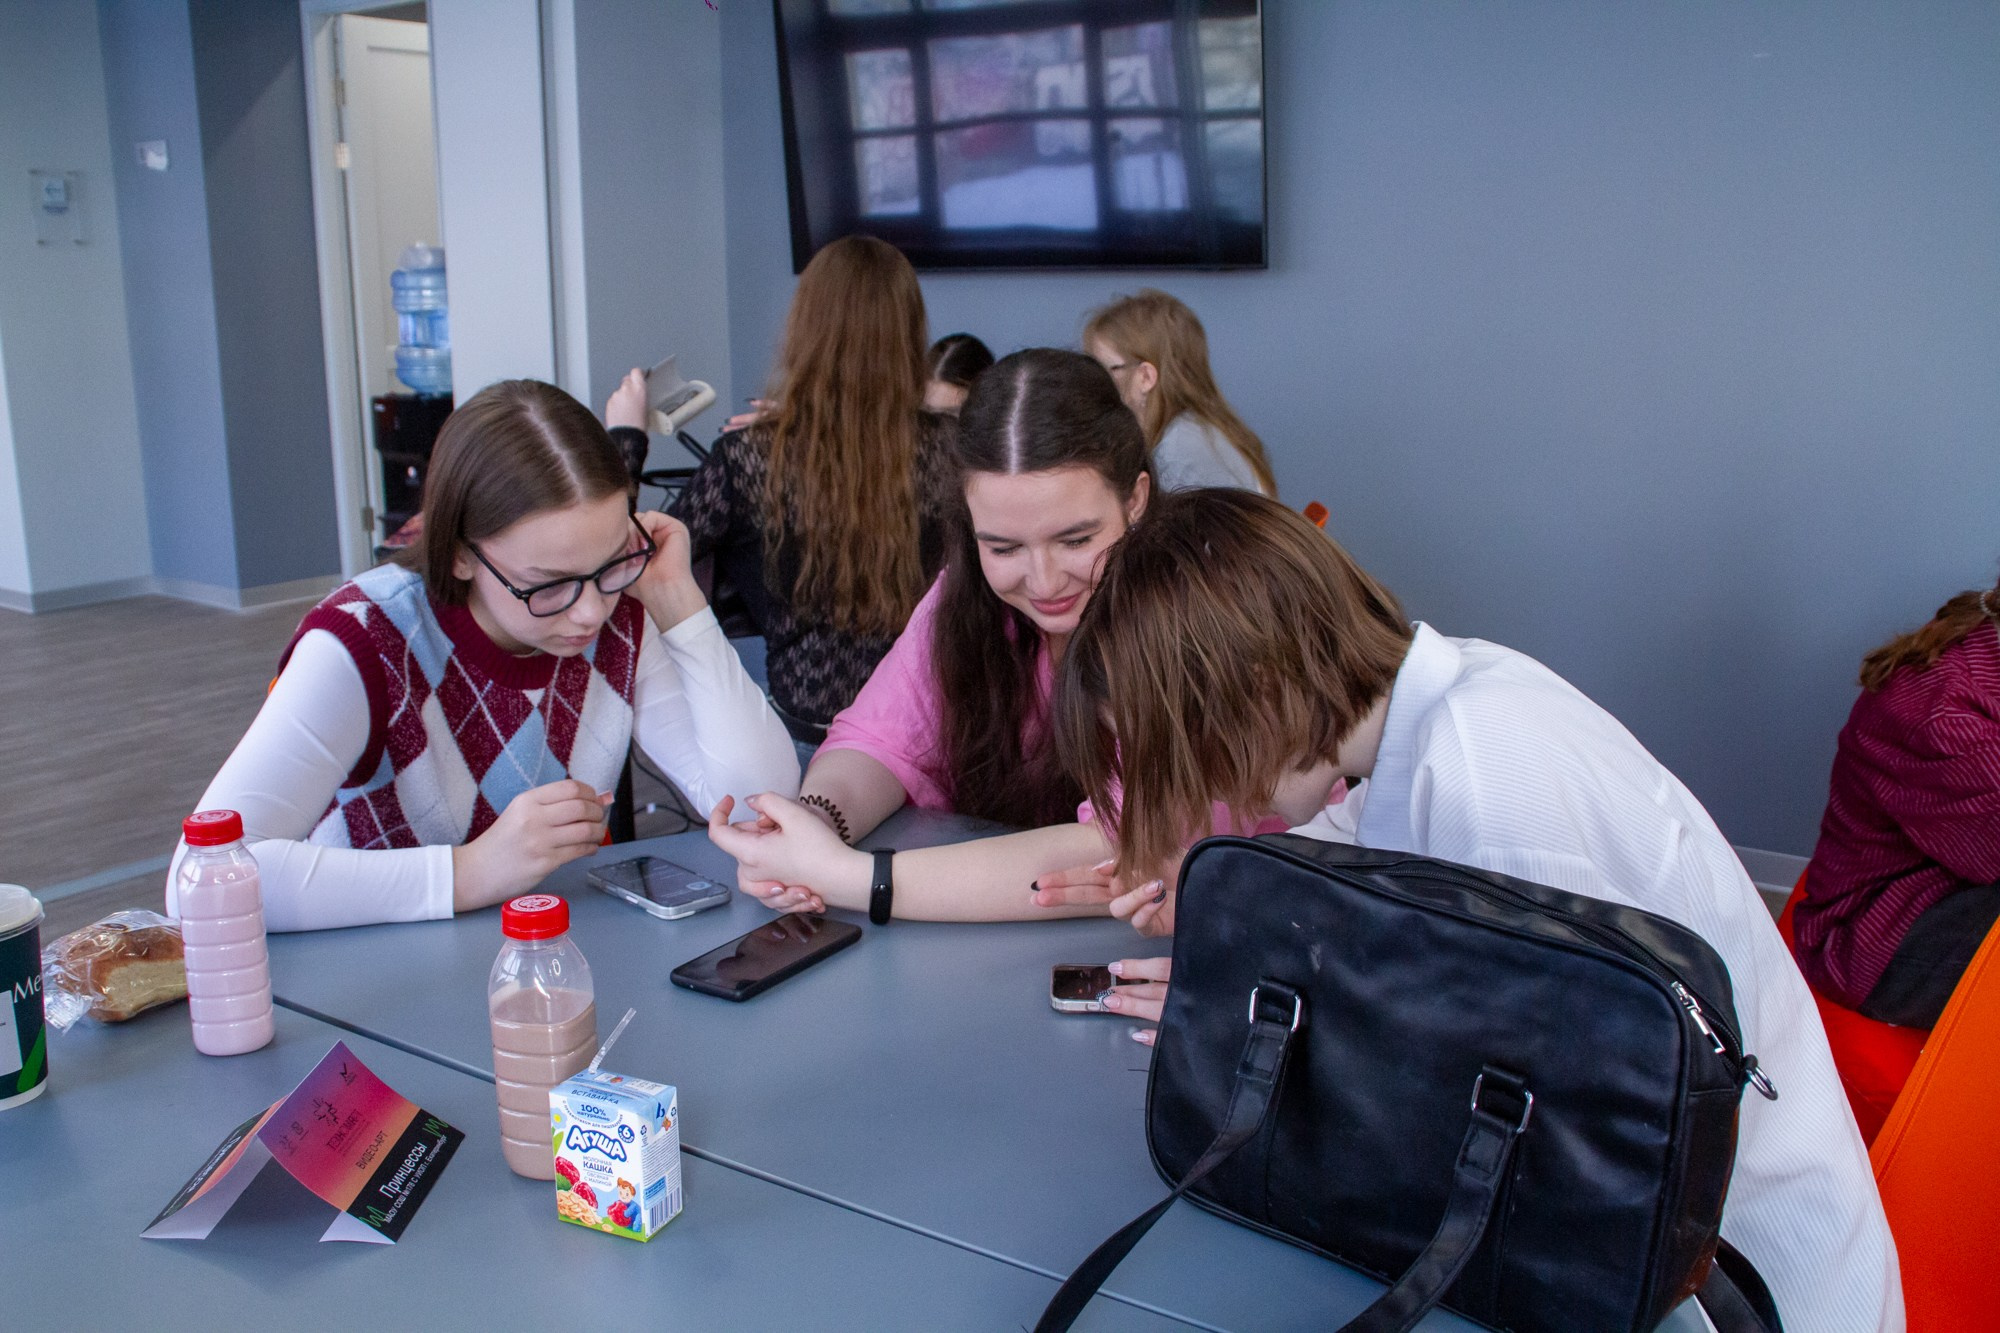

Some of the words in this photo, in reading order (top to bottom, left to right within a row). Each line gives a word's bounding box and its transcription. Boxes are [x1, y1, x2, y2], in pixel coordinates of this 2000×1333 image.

[581, 1104, 606, 1116] 100%
[355, 1130, 387, 1170] ВИДЕО-АРТ
[379, 1141, 427, 1198] Принцессы
[583, 1161, 613, 1174] КАШКА
[384, 1206, 398, 1223] МАОУ
[394, 1195, 406, 1208] СОШ
[425, 1134, 447, 1162] Екатеринбург
